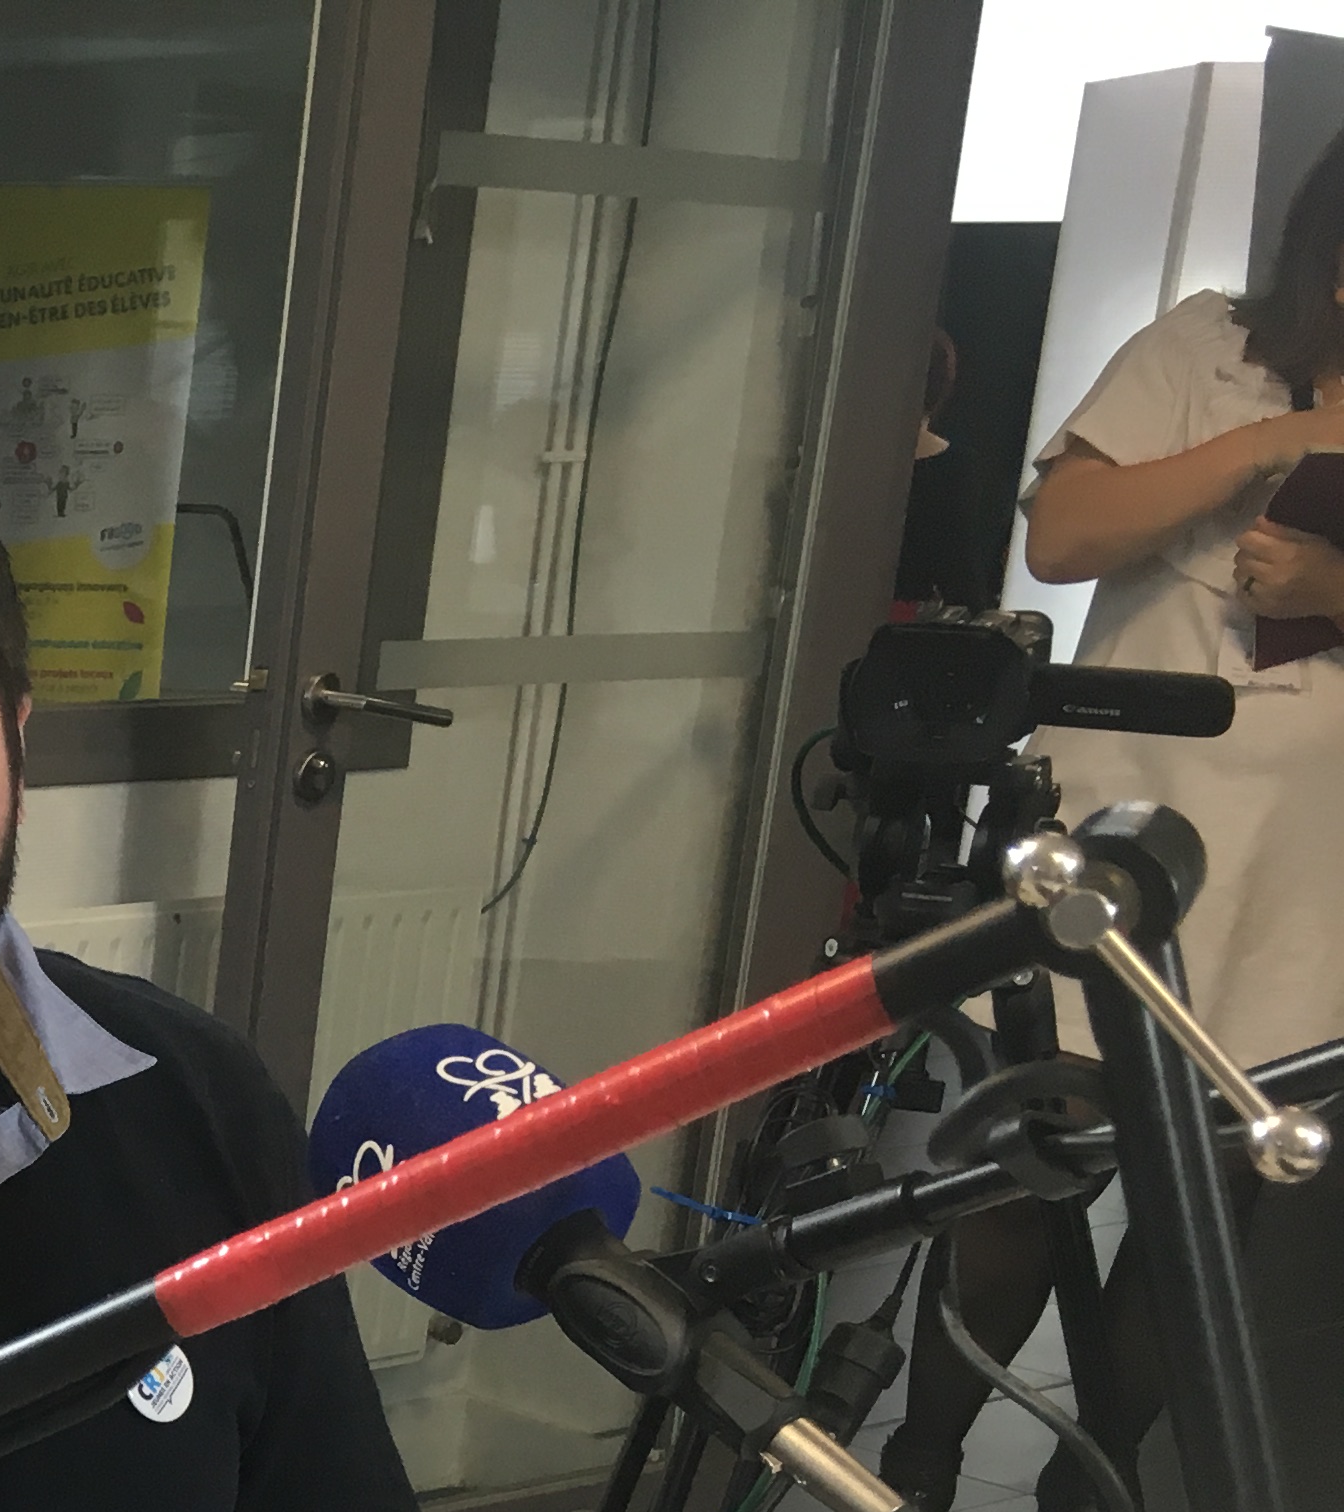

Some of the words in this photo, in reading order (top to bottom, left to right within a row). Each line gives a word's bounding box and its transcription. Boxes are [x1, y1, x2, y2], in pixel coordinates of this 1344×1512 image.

[74, 299, 108, 319] DES
[110, 289, 172, 314] ÉLÈVES
[1062, 703, 1121, 717] Canon
